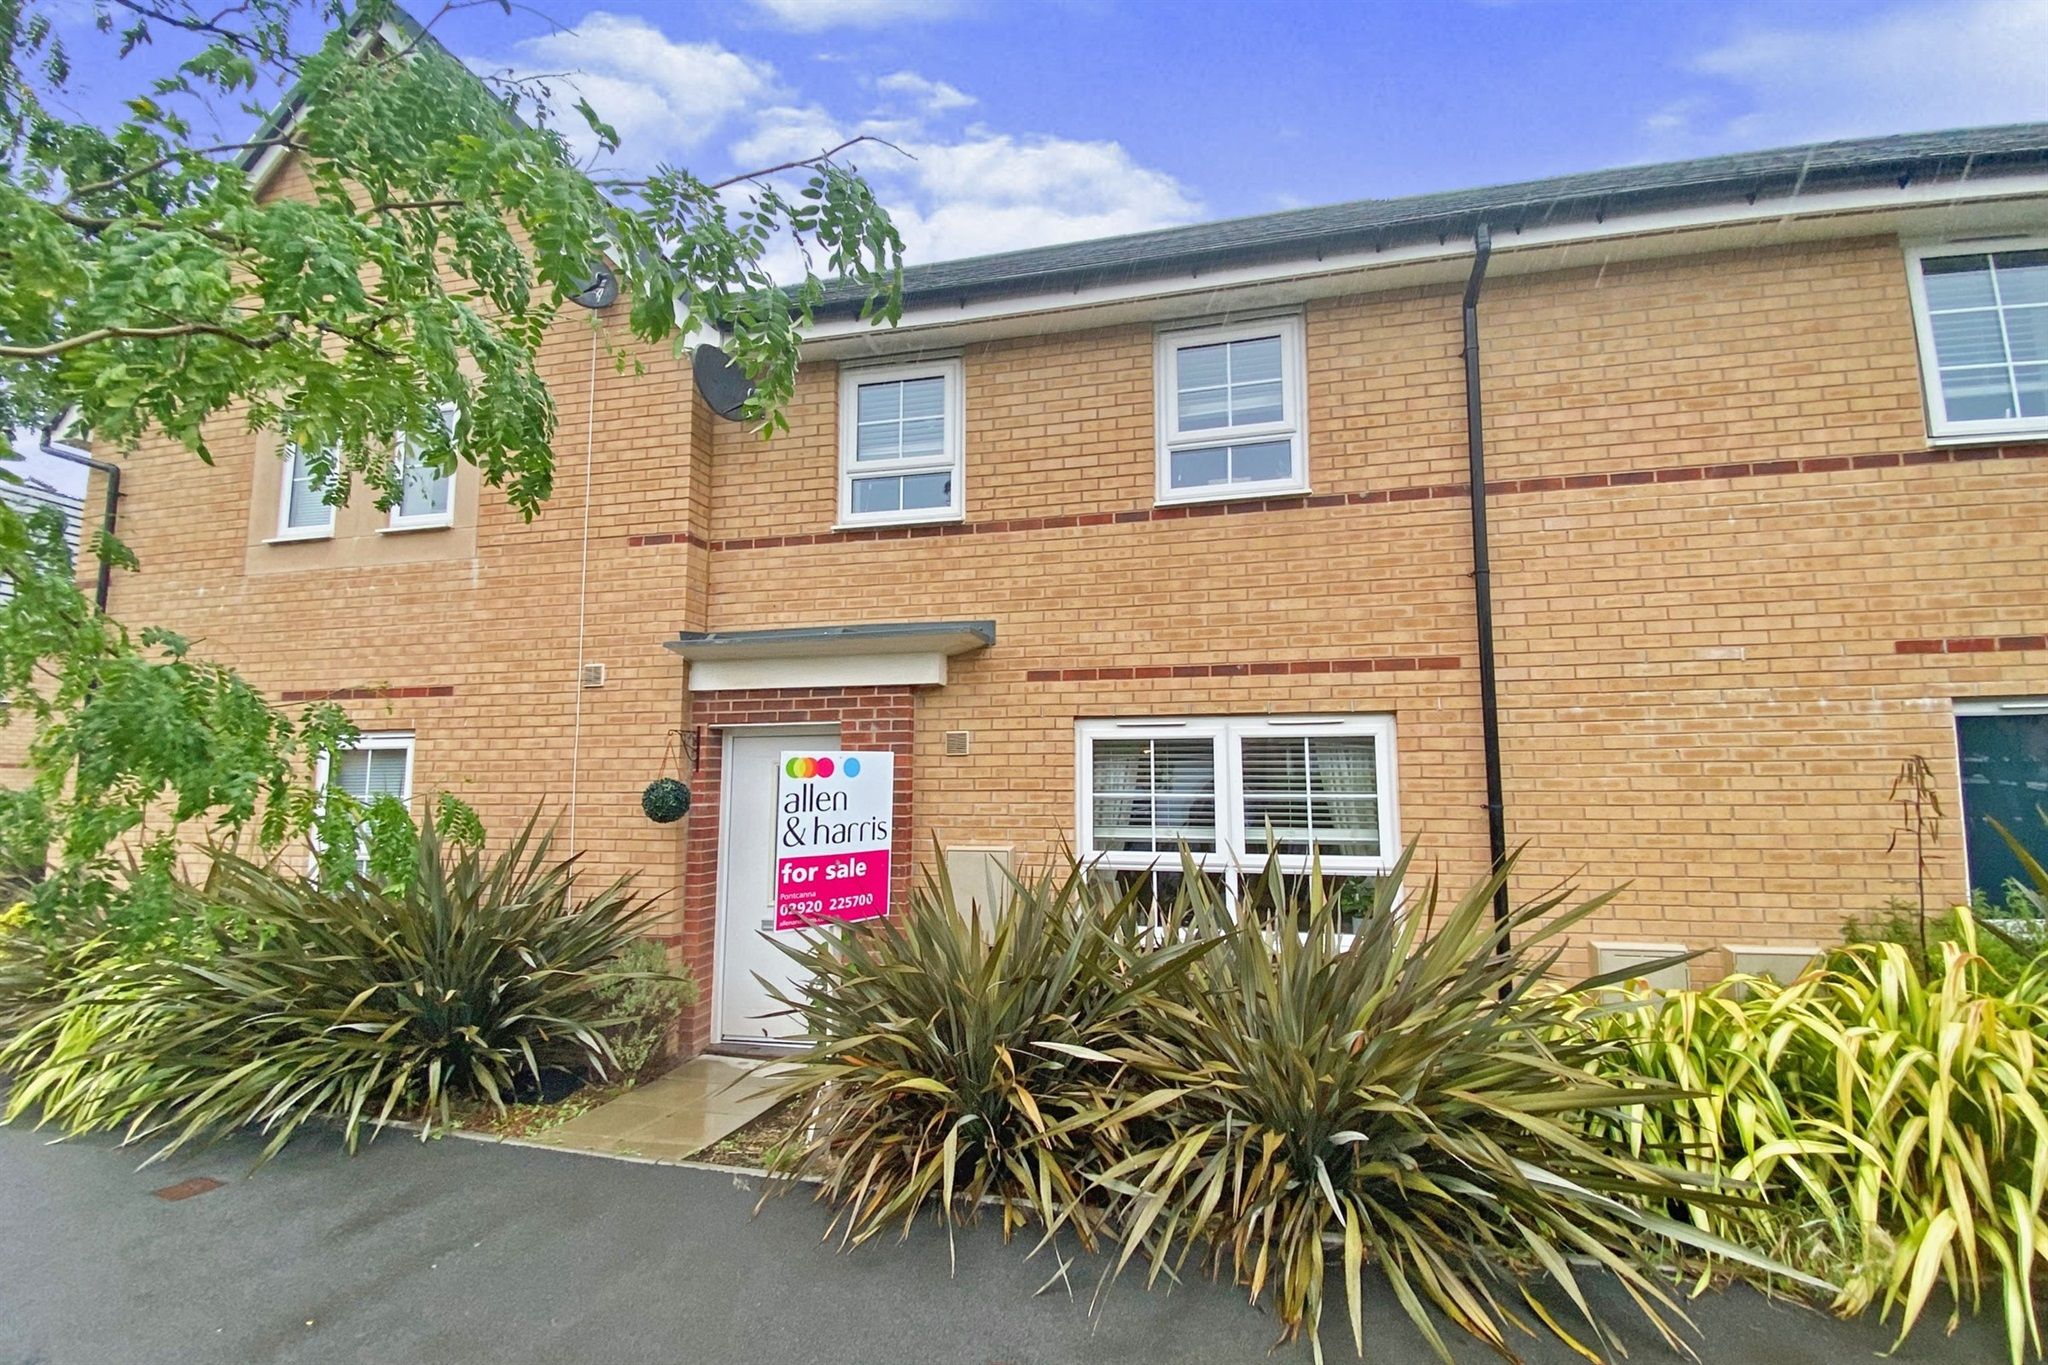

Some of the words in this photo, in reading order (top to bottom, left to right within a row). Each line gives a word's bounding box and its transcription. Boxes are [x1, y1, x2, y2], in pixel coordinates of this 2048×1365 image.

[784, 783, 847, 813] allen
[783, 816, 806, 847] &
[813, 816, 888, 845] harris
[781, 862, 819, 884] for
[825, 858, 867, 880] sale
[779, 901, 823, 916] 02920
[829, 893, 873, 911] 225700
[780, 891, 816, 901] Pontcanna
